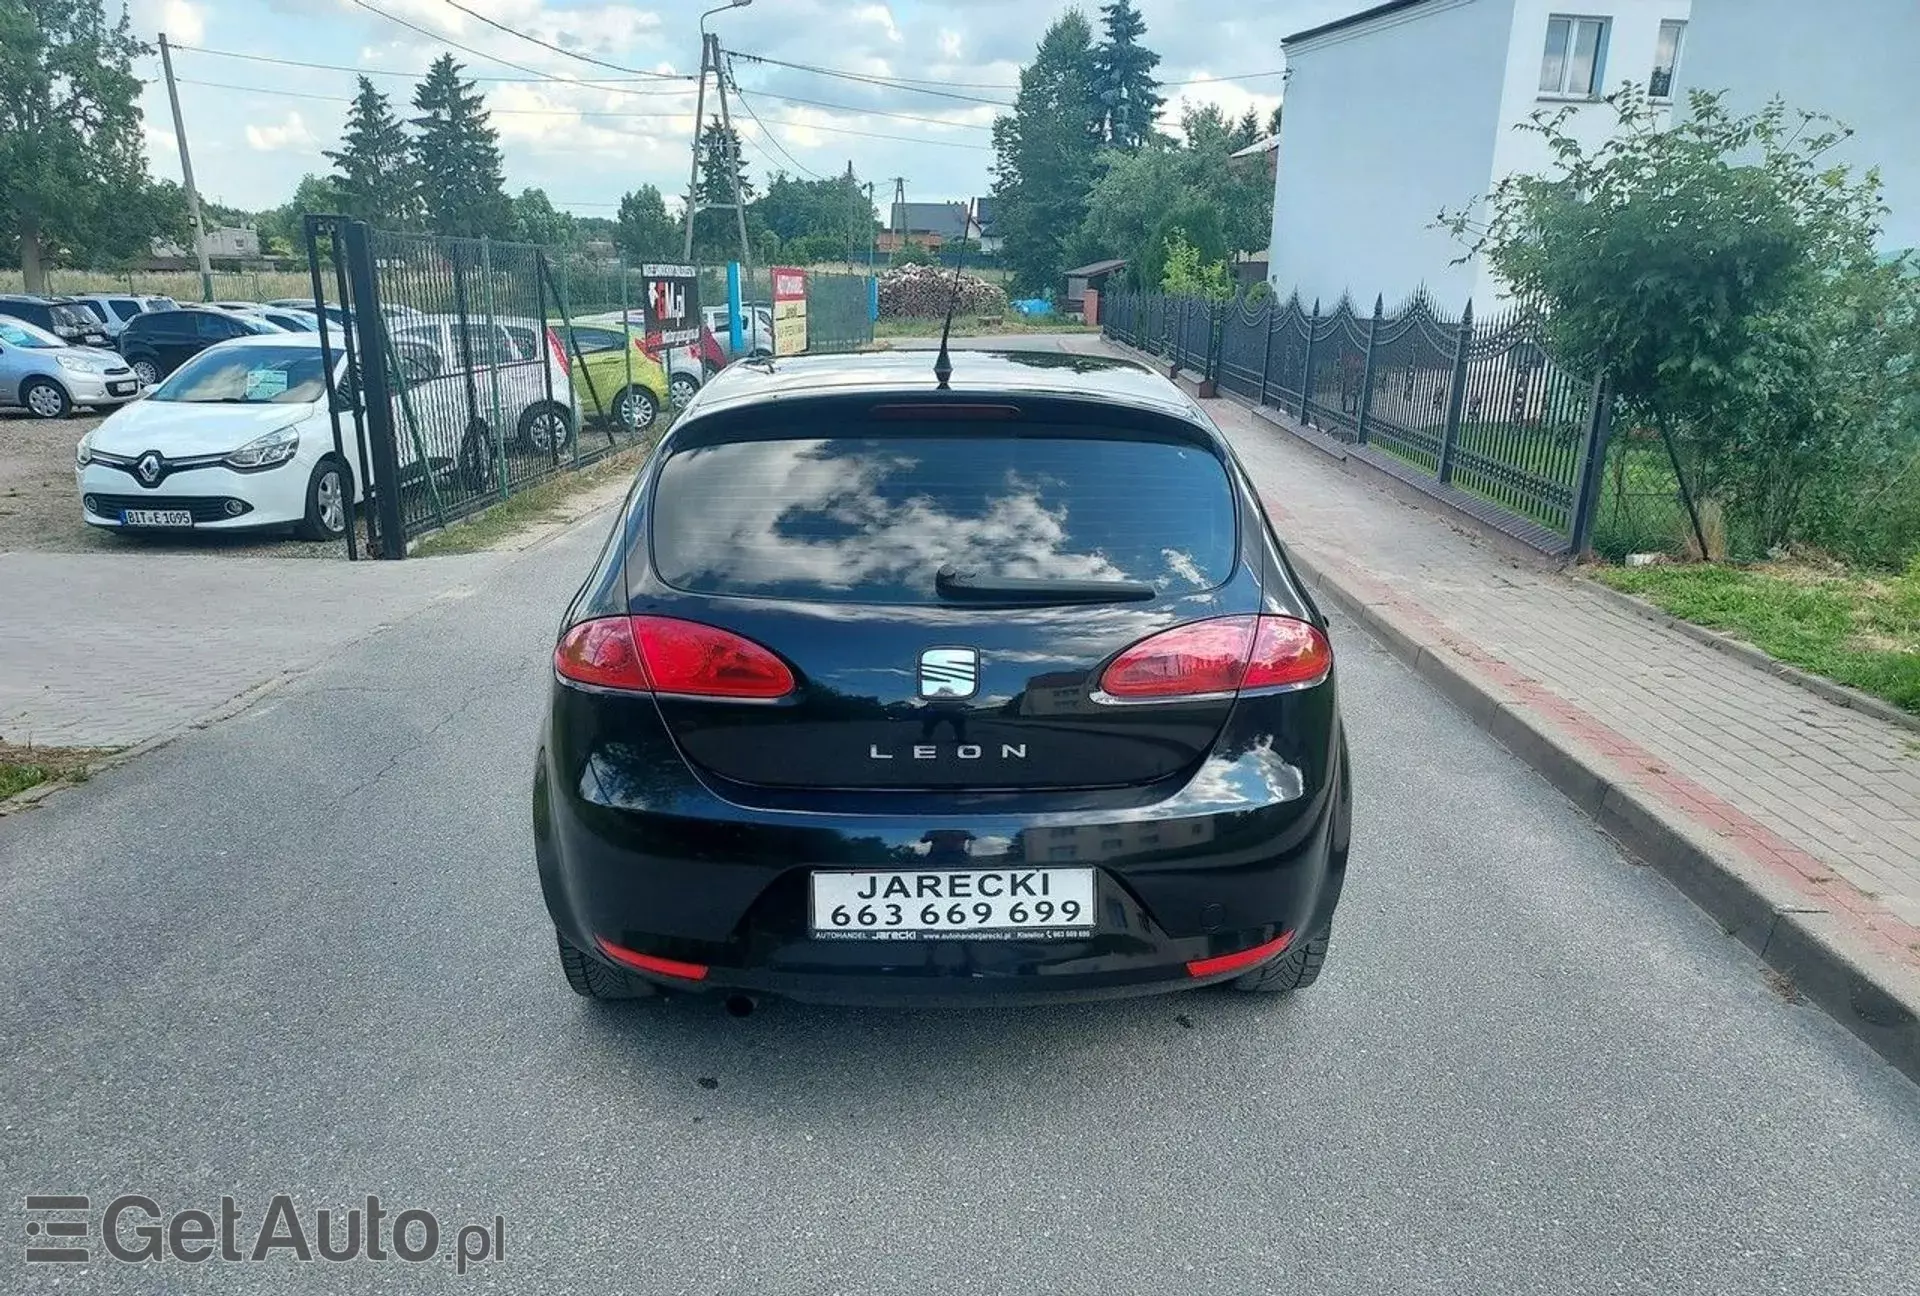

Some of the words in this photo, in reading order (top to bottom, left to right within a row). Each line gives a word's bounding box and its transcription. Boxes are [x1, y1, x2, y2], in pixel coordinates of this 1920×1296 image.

[127, 511, 146, 523] BIT
[163, 512, 190, 524] 1095
[870, 744, 1027, 759] LEON
[857, 872, 1049, 899] JARECKI
[831, 904, 903, 926] 663
[920, 902, 993, 926] 669
[1008, 900, 1081, 924] 699
[815, 931, 868, 940] AUTOHANDEL
